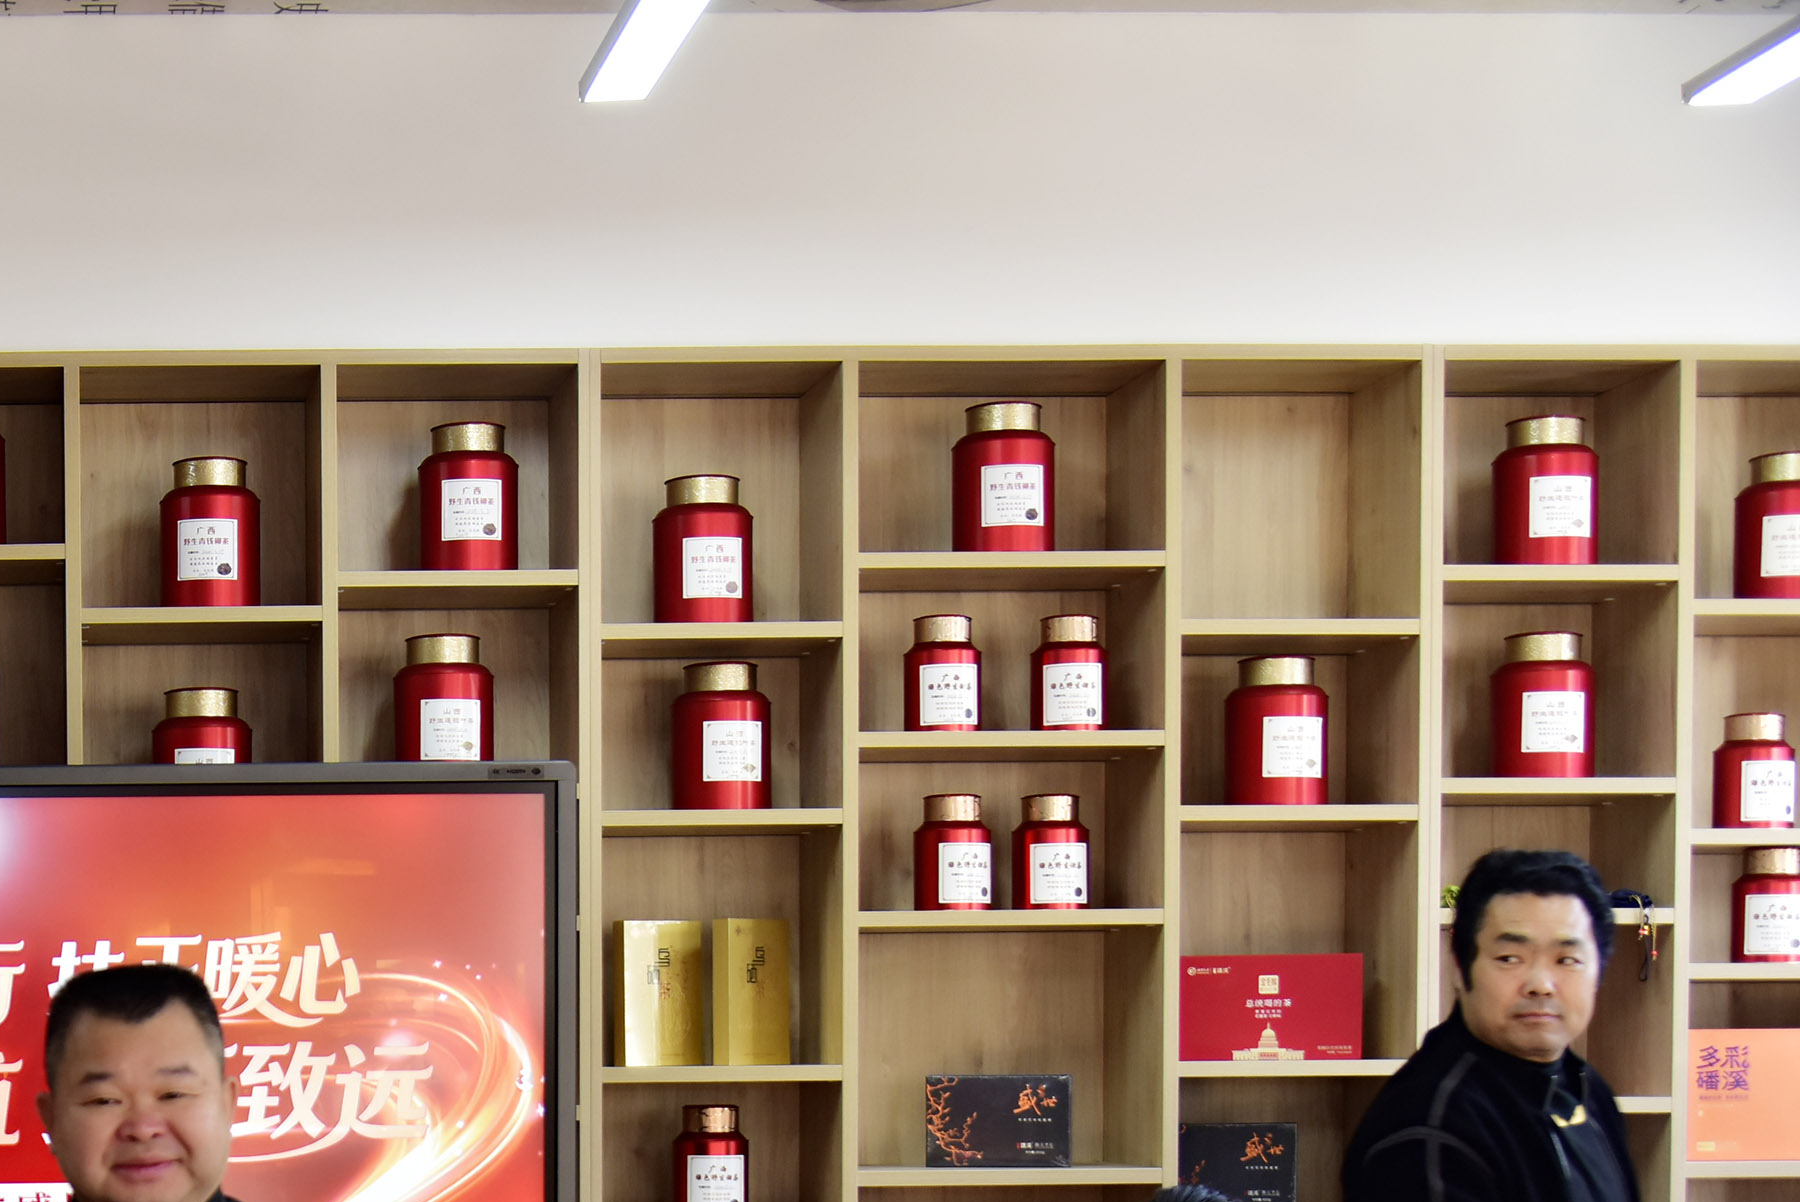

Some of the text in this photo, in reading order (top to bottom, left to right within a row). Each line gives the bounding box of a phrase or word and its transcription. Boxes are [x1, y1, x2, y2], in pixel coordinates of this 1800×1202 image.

[463, 487, 481, 495] 广西
[705, 545, 724, 553] 广西
[1064, 673, 1082, 681] 广西
[1696, 1046, 1750, 1069] 多彩
[1696, 1070, 1749, 1091] 磻溪
[708, 1165, 726, 1173] 广西
